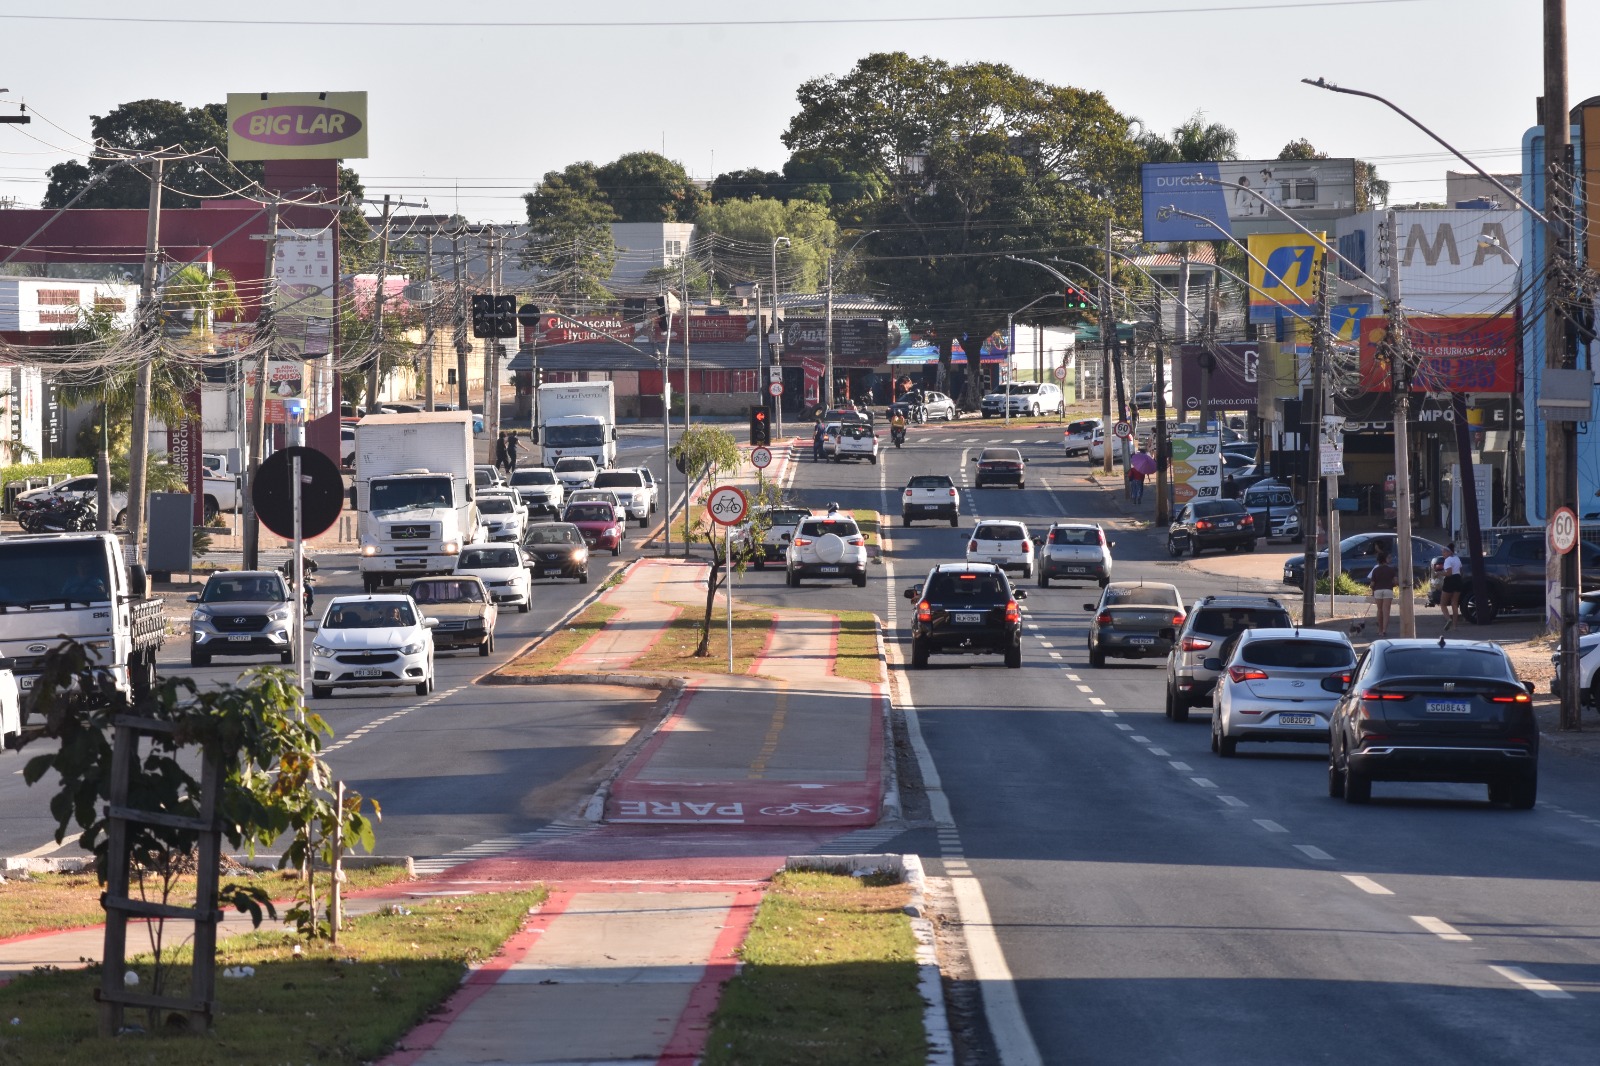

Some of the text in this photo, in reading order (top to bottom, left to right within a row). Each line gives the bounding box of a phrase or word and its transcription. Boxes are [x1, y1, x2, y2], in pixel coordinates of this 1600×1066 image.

[249, 114, 345, 135] BIG LAR
[302, 286, 318, 294] LAR
[272, 374, 300, 382] SOUSA
[1117, 424, 1128, 432] 60
[180, 413, 189, 483] REGISTRO CIVIL
[1199, 445, 1215, 453] 3.94
[1200, 466, 1217, 475] 5.94
[1200, 487, 1217, 495] 6.01
[1556, 516, 1573, 536] 60
[1430, 703, 1467, 712] SCU8E43
[619, 801, 744, 816] PARE
